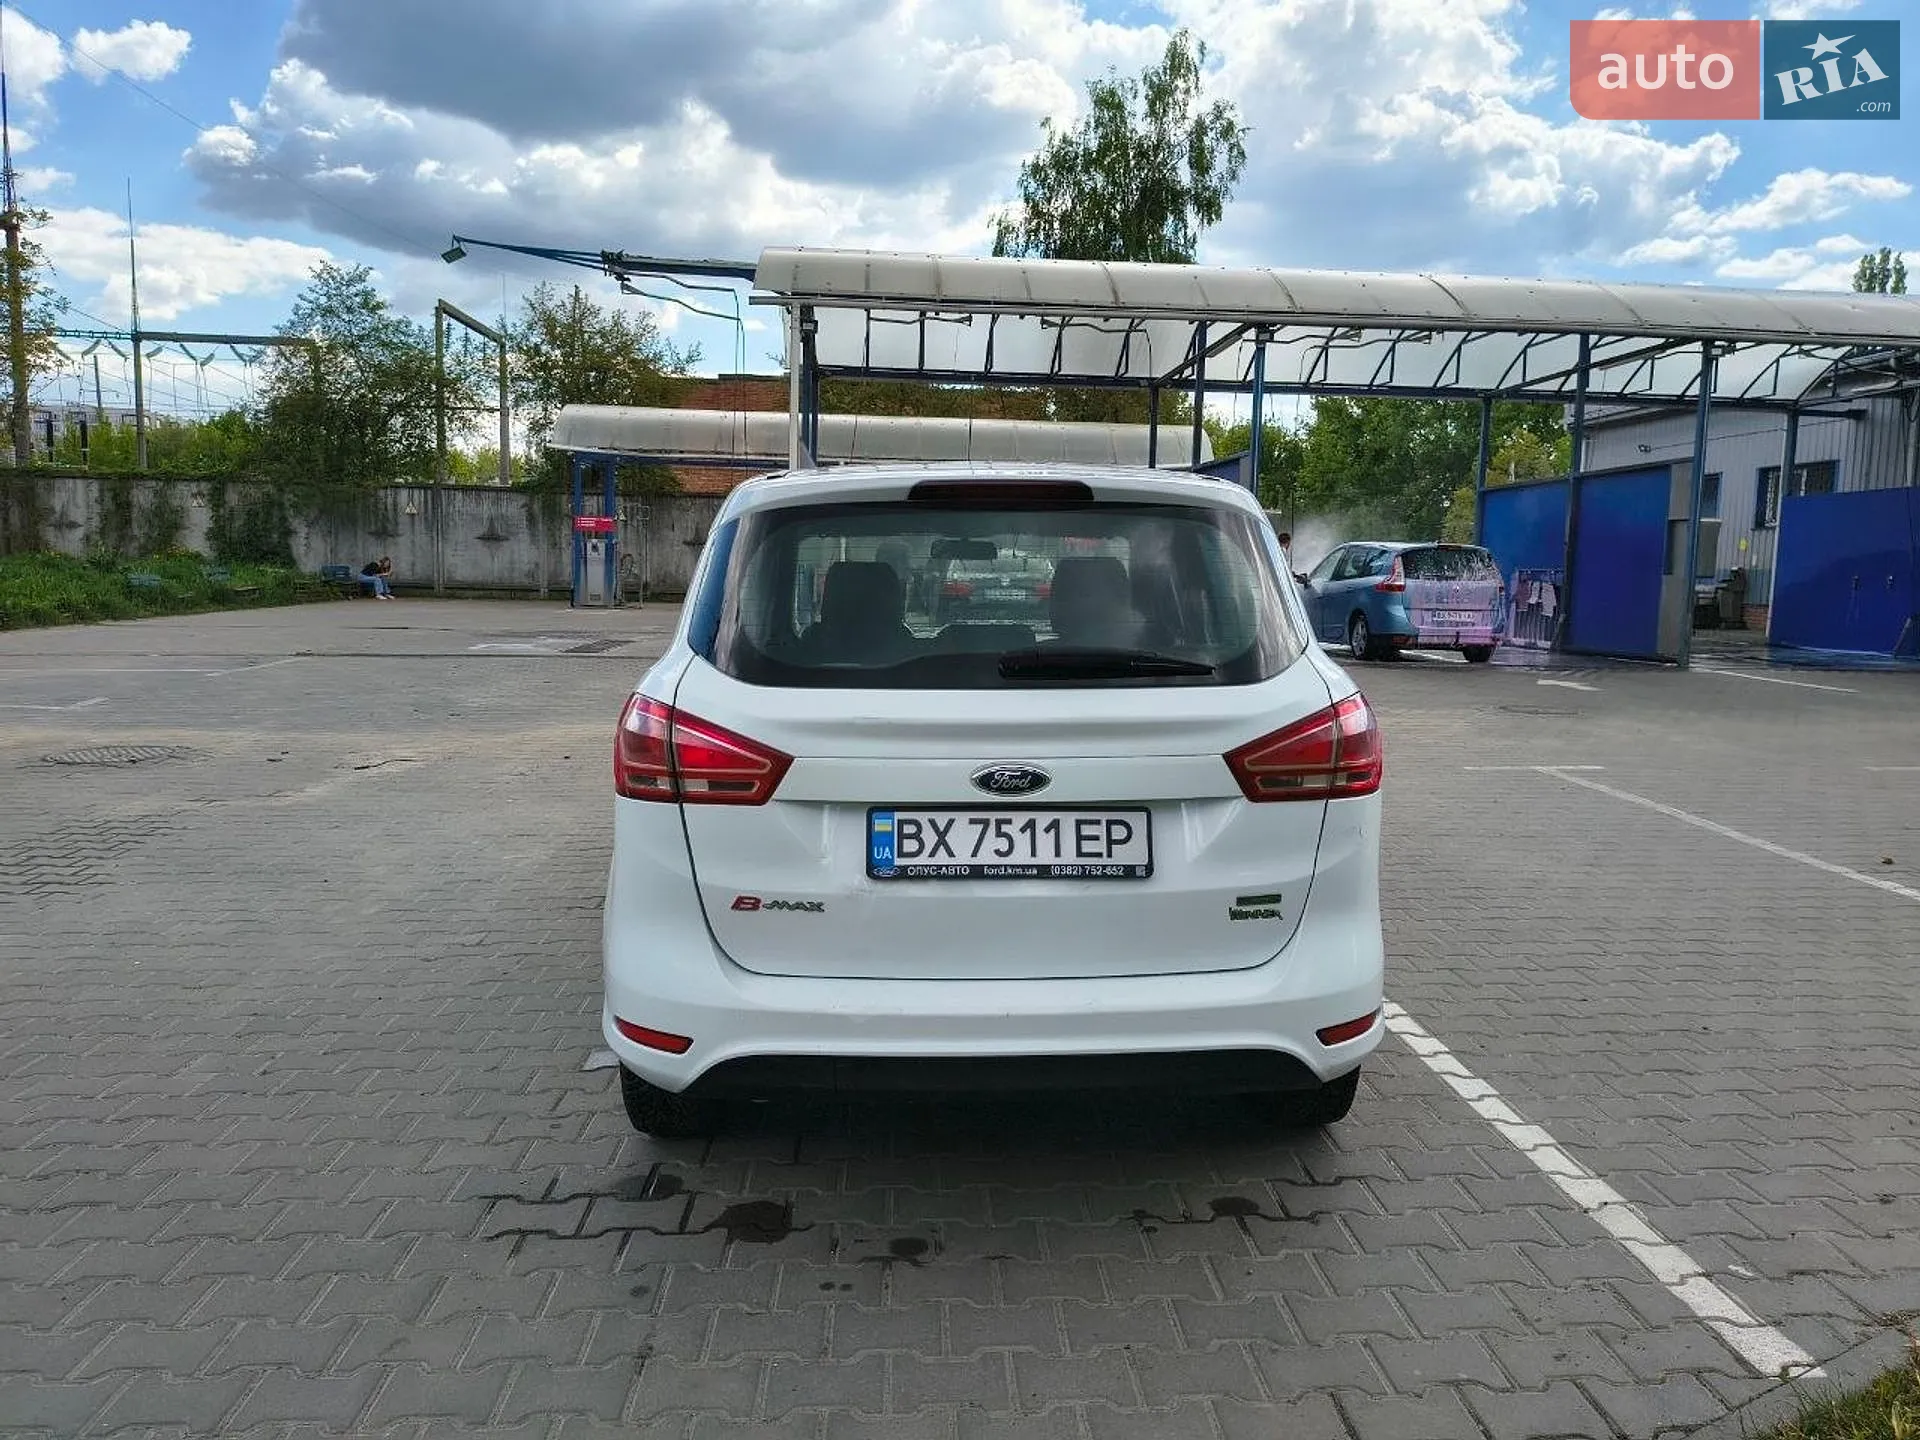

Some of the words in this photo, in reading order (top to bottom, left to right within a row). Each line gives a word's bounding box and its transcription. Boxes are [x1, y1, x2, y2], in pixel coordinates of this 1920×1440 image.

[990, 771, 1032, 788] Ford
[897, 818, 956, 859] BX
[968, 818, 1062, 859] 7511
[1075, 818, 1133, 859] EP
[874, 846, 892, 859] UA
[907, 866, 970, 876] ОПУС-АВТО
[1051, 865, 1082, 876] (0382)
